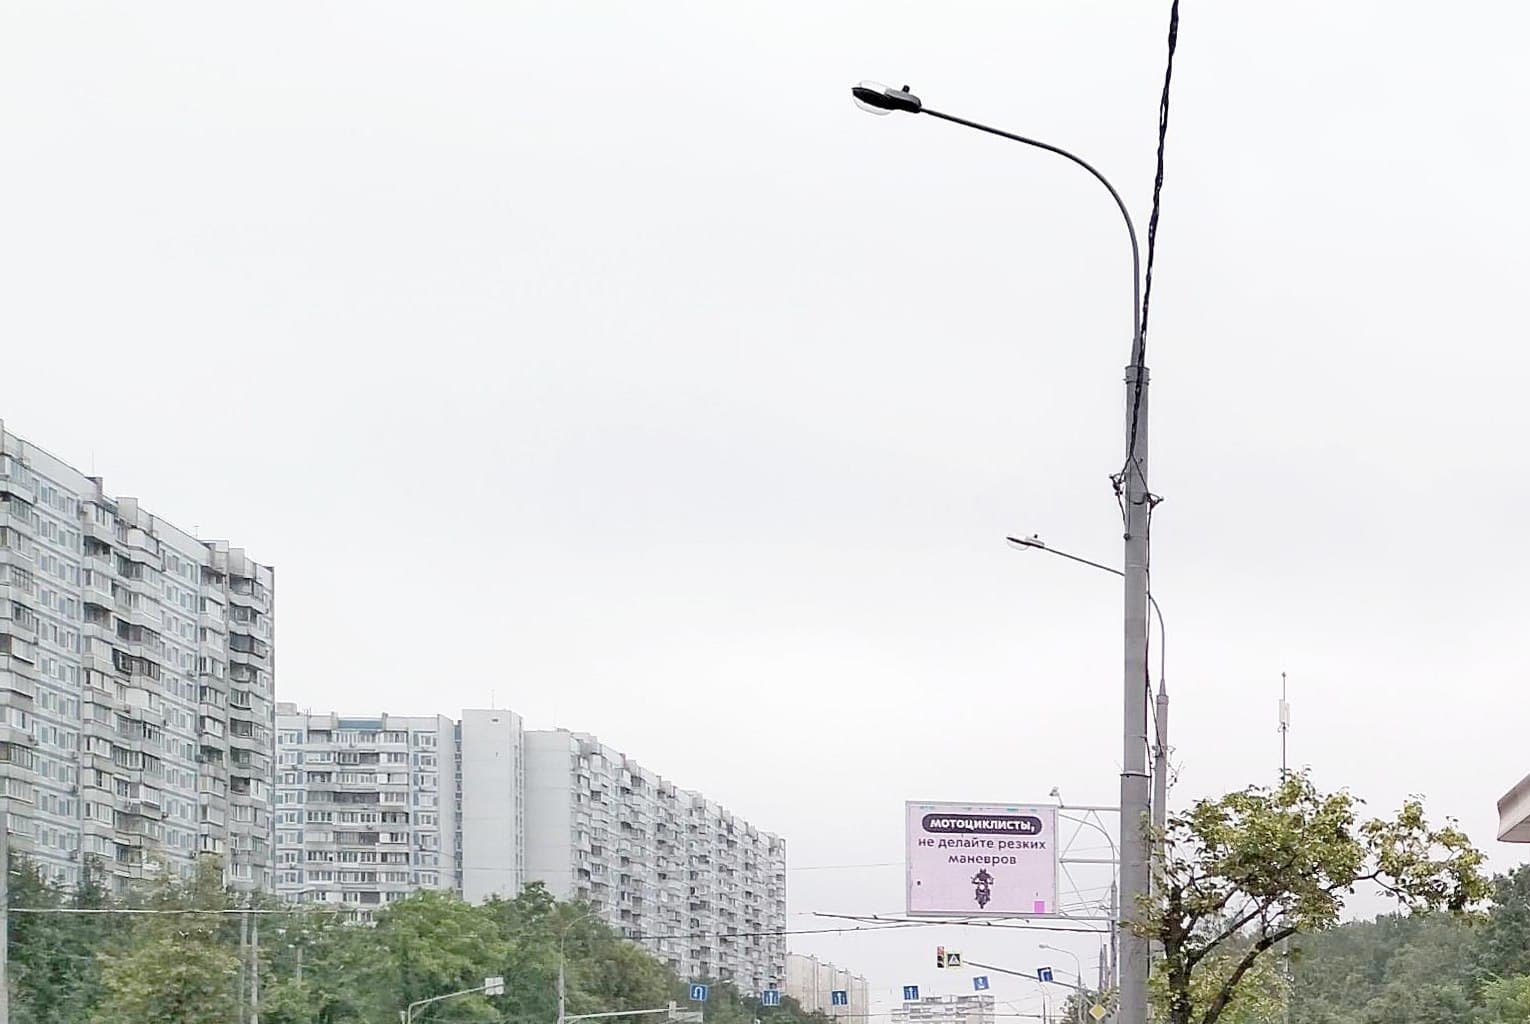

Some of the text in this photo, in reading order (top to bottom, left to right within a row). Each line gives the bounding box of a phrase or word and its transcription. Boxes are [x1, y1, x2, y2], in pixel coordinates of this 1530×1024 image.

[918, 837, 1046, 851] не делайте резких
[948, 854, 1017, 867] маневров
